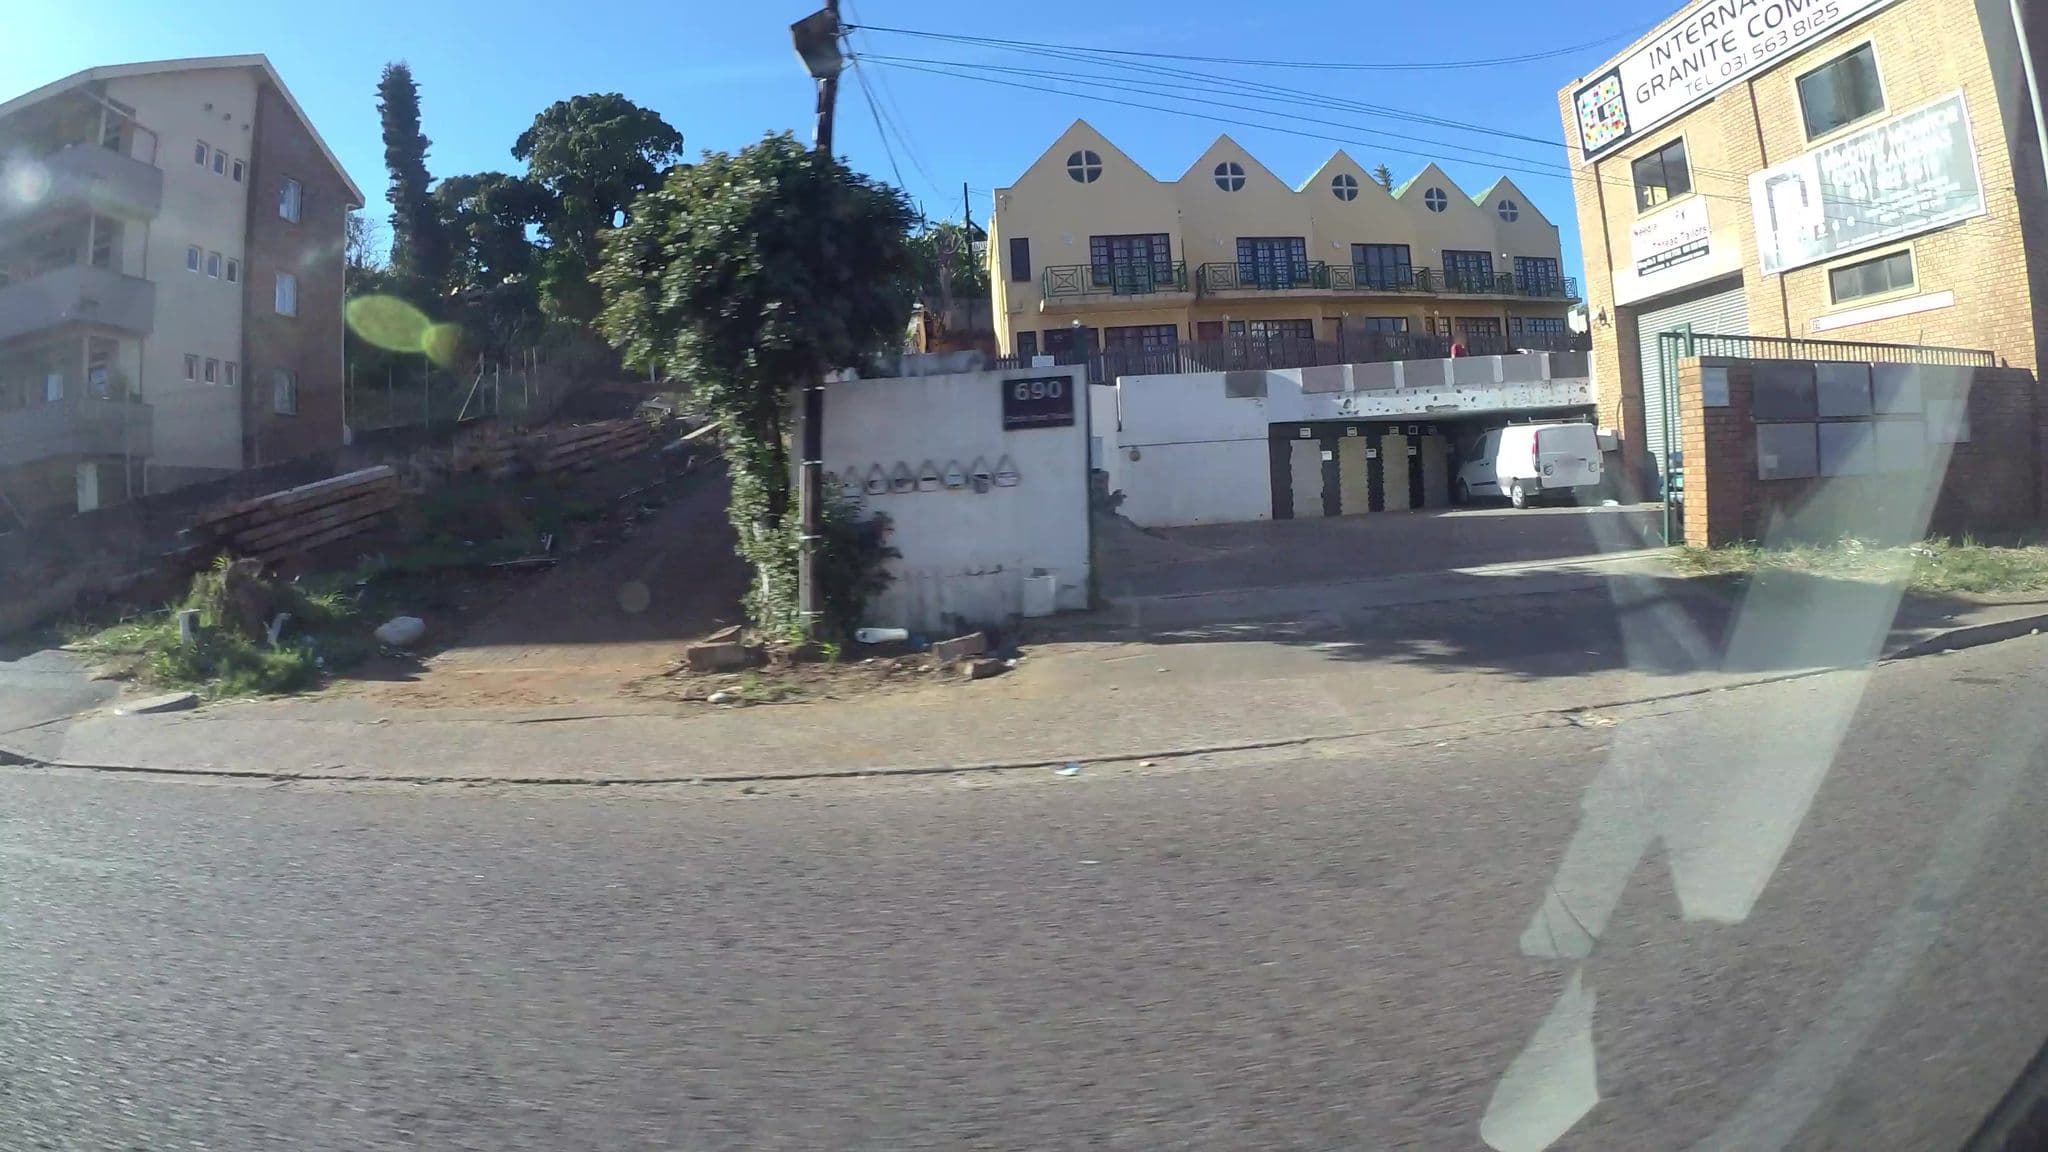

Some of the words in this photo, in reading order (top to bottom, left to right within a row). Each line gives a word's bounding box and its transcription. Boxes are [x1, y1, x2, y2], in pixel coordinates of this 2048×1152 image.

[1636, 30, 1737, 104] GRANITE
[1747, 0, 1819, 38] COM
[1649, 0, 1763, 69] INTERNA
[1685, 74, 1713, 96] TEL
[1720, 53, 1747, 76] 031
[1752, 30, 1788, 60] 563
[1793, 1, 1839, 37] 8125
[1015, 381, 1062, 400] 690
